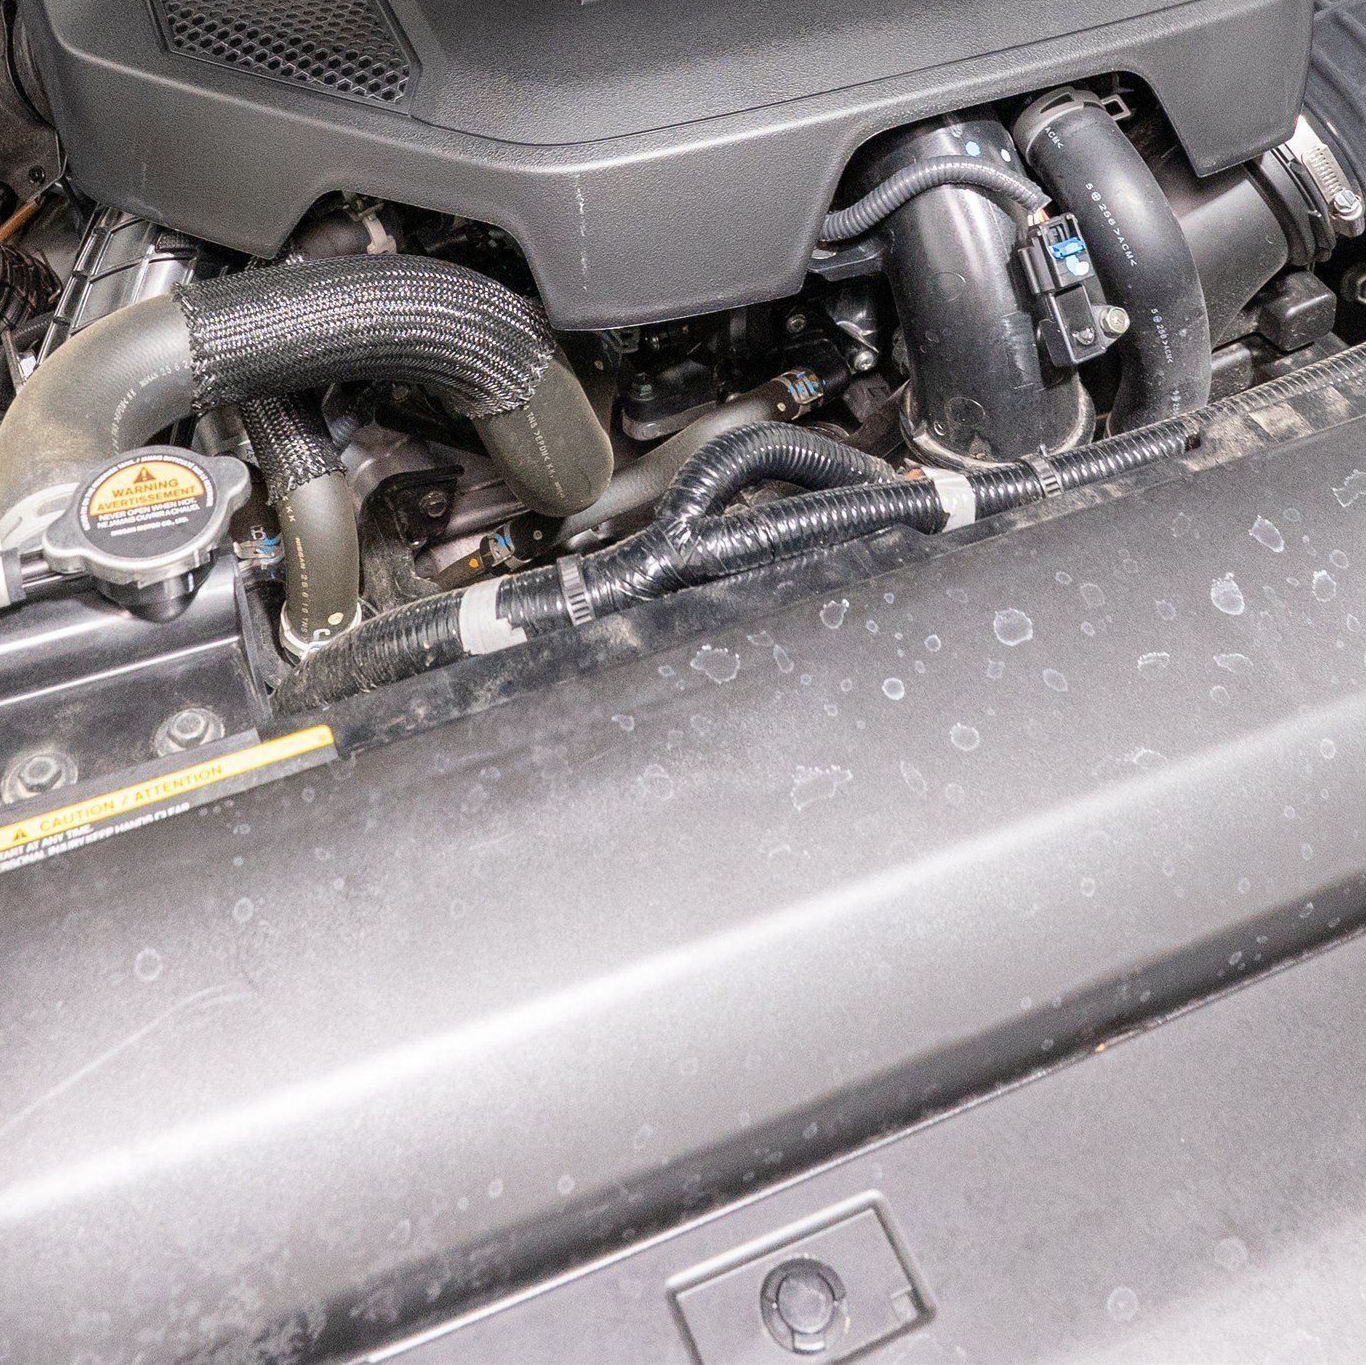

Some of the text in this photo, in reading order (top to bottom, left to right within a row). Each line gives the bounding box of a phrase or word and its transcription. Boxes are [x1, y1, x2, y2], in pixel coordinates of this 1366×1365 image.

[1045, 125, 1064, 149] ACM<
[97, 485, 196, 511] AVERTISSEMENT
[112, 479, 178, 498] WARNING
[127, 505, 151, 516] OPEN
[39, 799, 115, 832] CAUTION
[135, 765, 223, 802] ATTENTION
